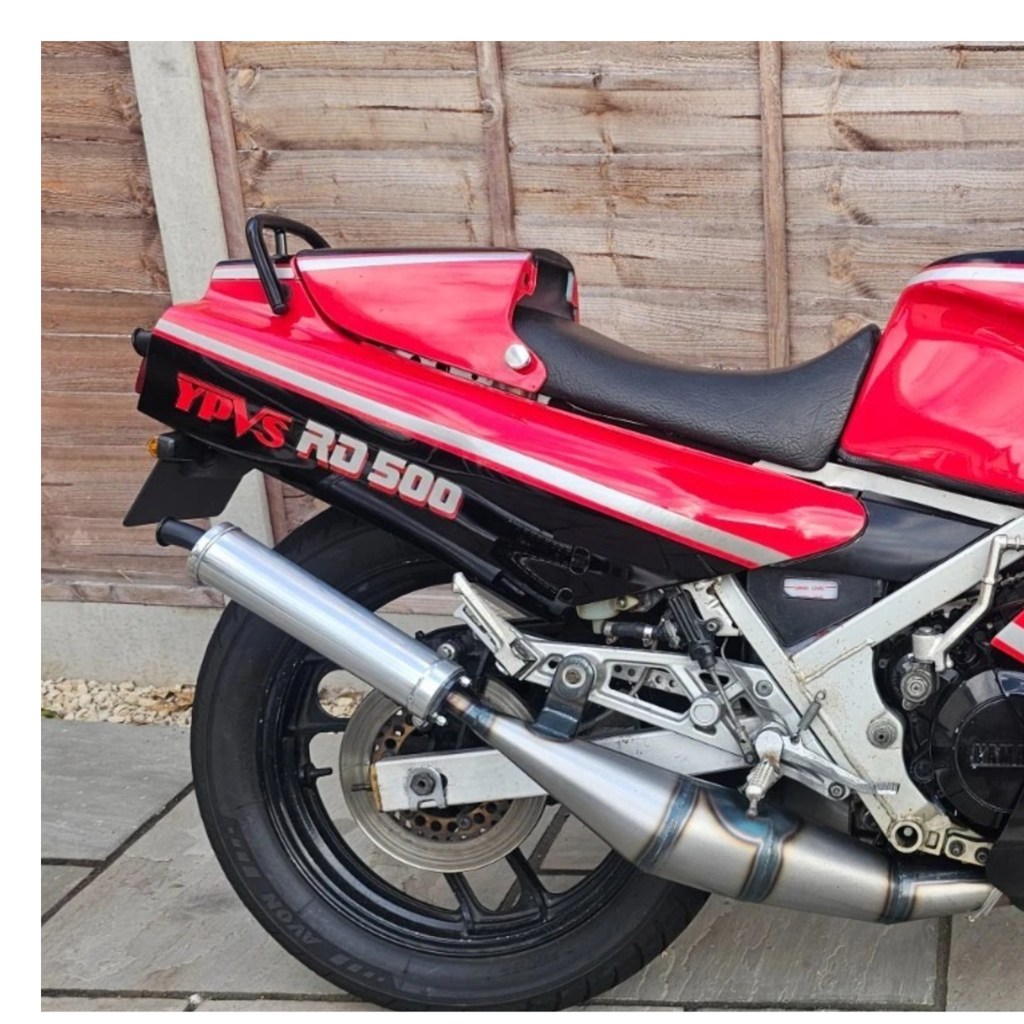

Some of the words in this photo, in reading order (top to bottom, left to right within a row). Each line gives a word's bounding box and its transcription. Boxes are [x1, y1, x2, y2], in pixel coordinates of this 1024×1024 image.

[175, 371, 293, 448] YPVS
[296, 419, 369, 480] RD
[367, 450, 464, 520] 500
[260, 893, 323, 945] AVON
